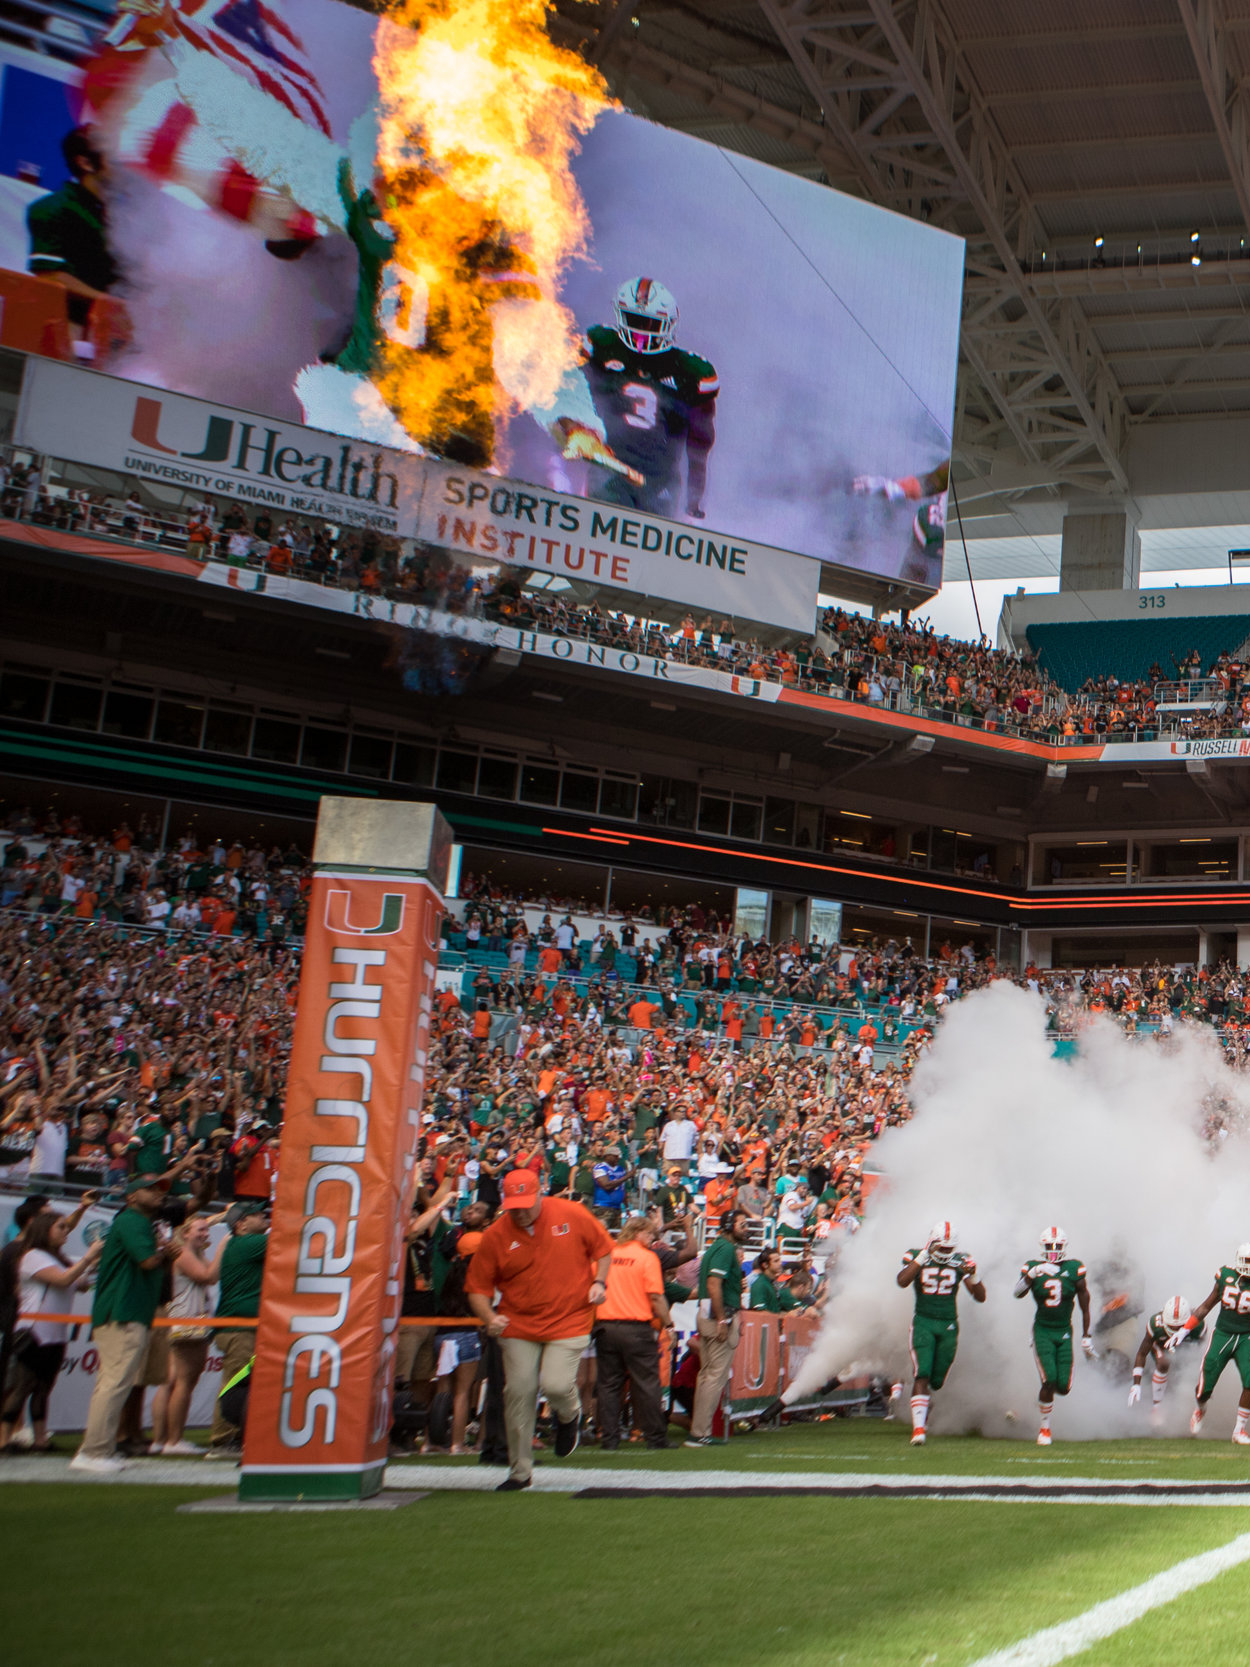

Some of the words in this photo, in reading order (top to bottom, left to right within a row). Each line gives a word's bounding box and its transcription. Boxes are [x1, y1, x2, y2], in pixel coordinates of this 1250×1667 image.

[622, 382, 658, 430] 3
[124, 456, 212, 488] UNIVERSITY
[215, 479, 235, 495] OF
[237, 484, 286, 507] MIAMI
[436, 513, 630, 583] INSTITUTE
[442, 476, 580, 532] SPORTS
[590, 511, 748, 575] MEDICINE
[1138, 595, 1166, 609] 313
[518, 631, 670, 679] HONOR
[1192, 740, 1238, 756] RUSSELL
[921, 1266, 957, 1295] 52
[1043, 1278, 1063, 1307] 3
